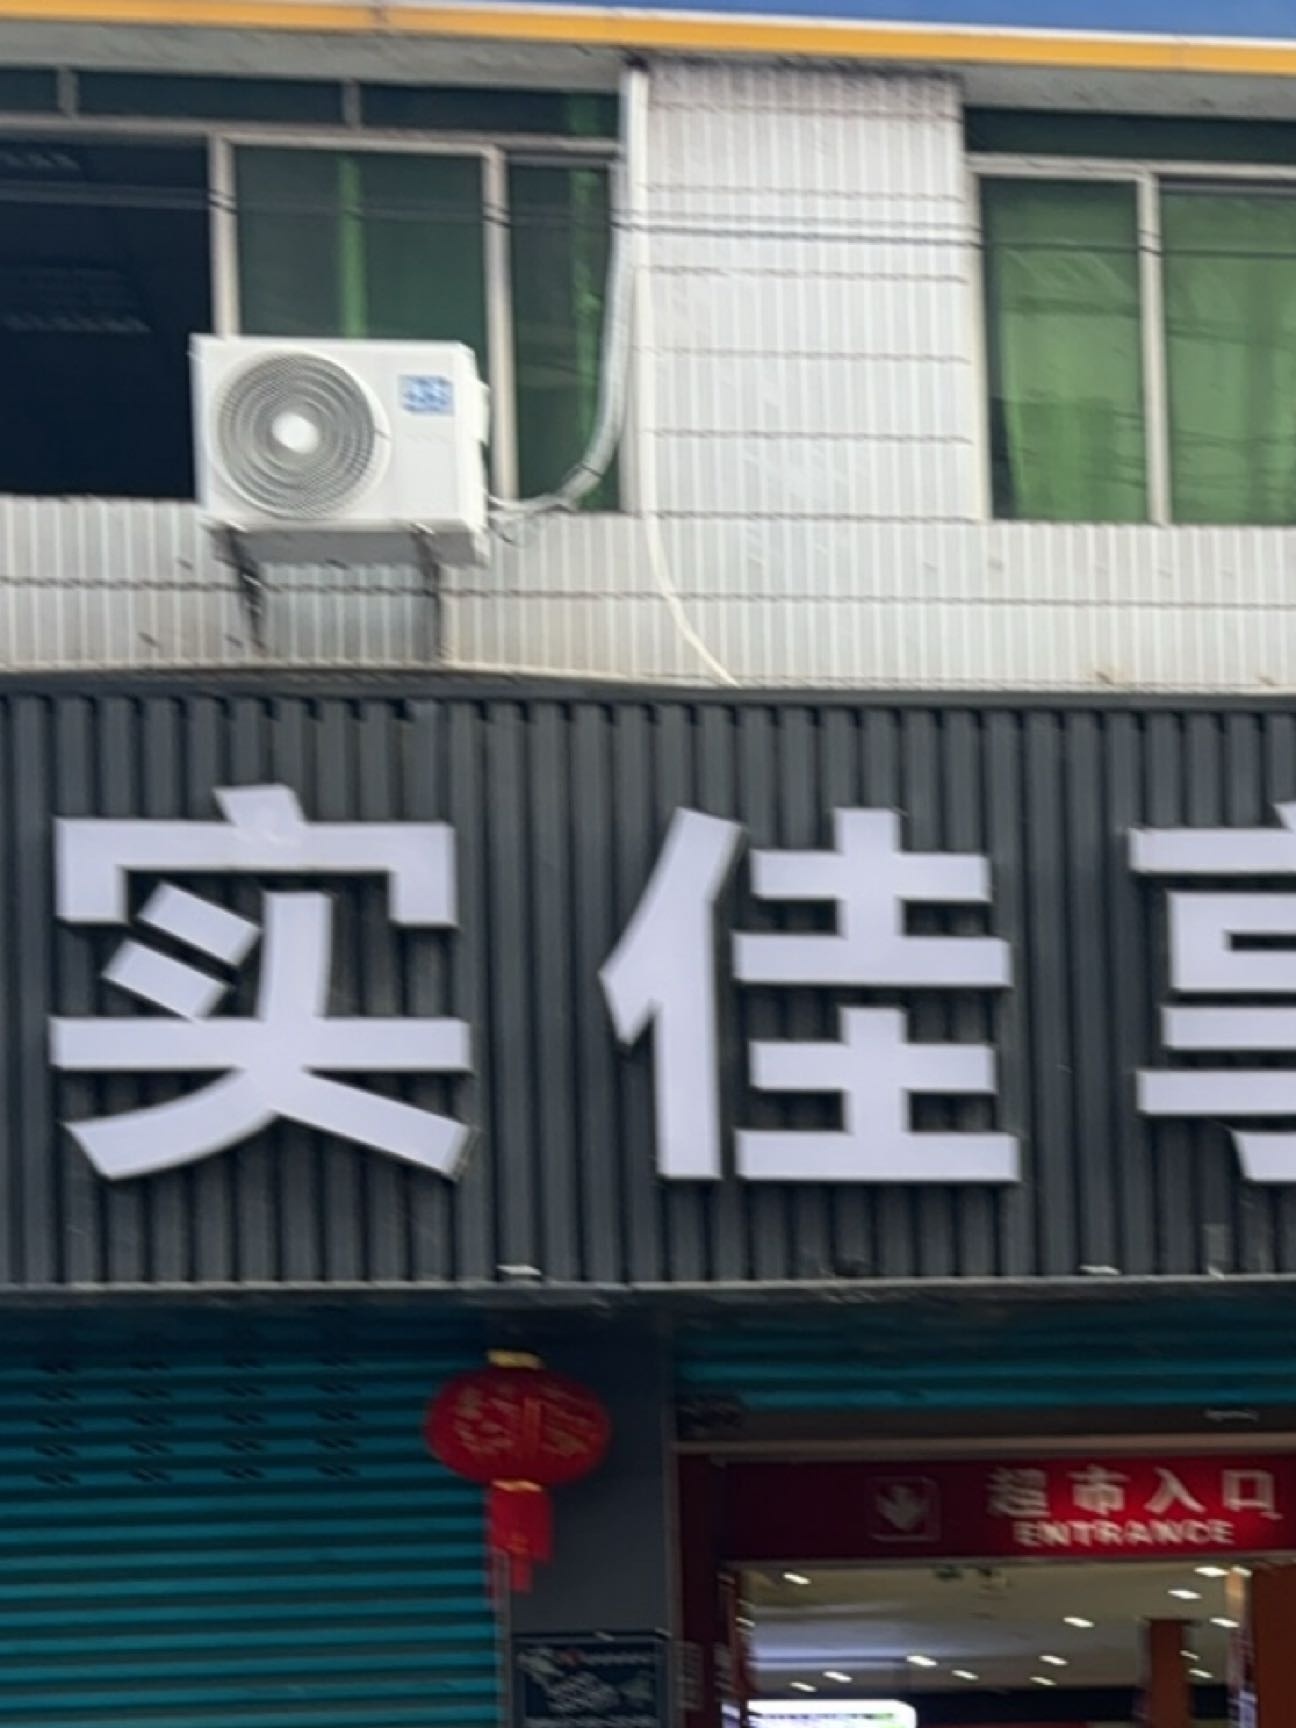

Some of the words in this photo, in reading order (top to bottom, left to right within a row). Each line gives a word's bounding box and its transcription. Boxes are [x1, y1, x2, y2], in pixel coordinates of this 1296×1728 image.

[987, 1464, 1280, 1519] 超市入口
[1013, 1518, 1236, 1547] ENTRANCE
